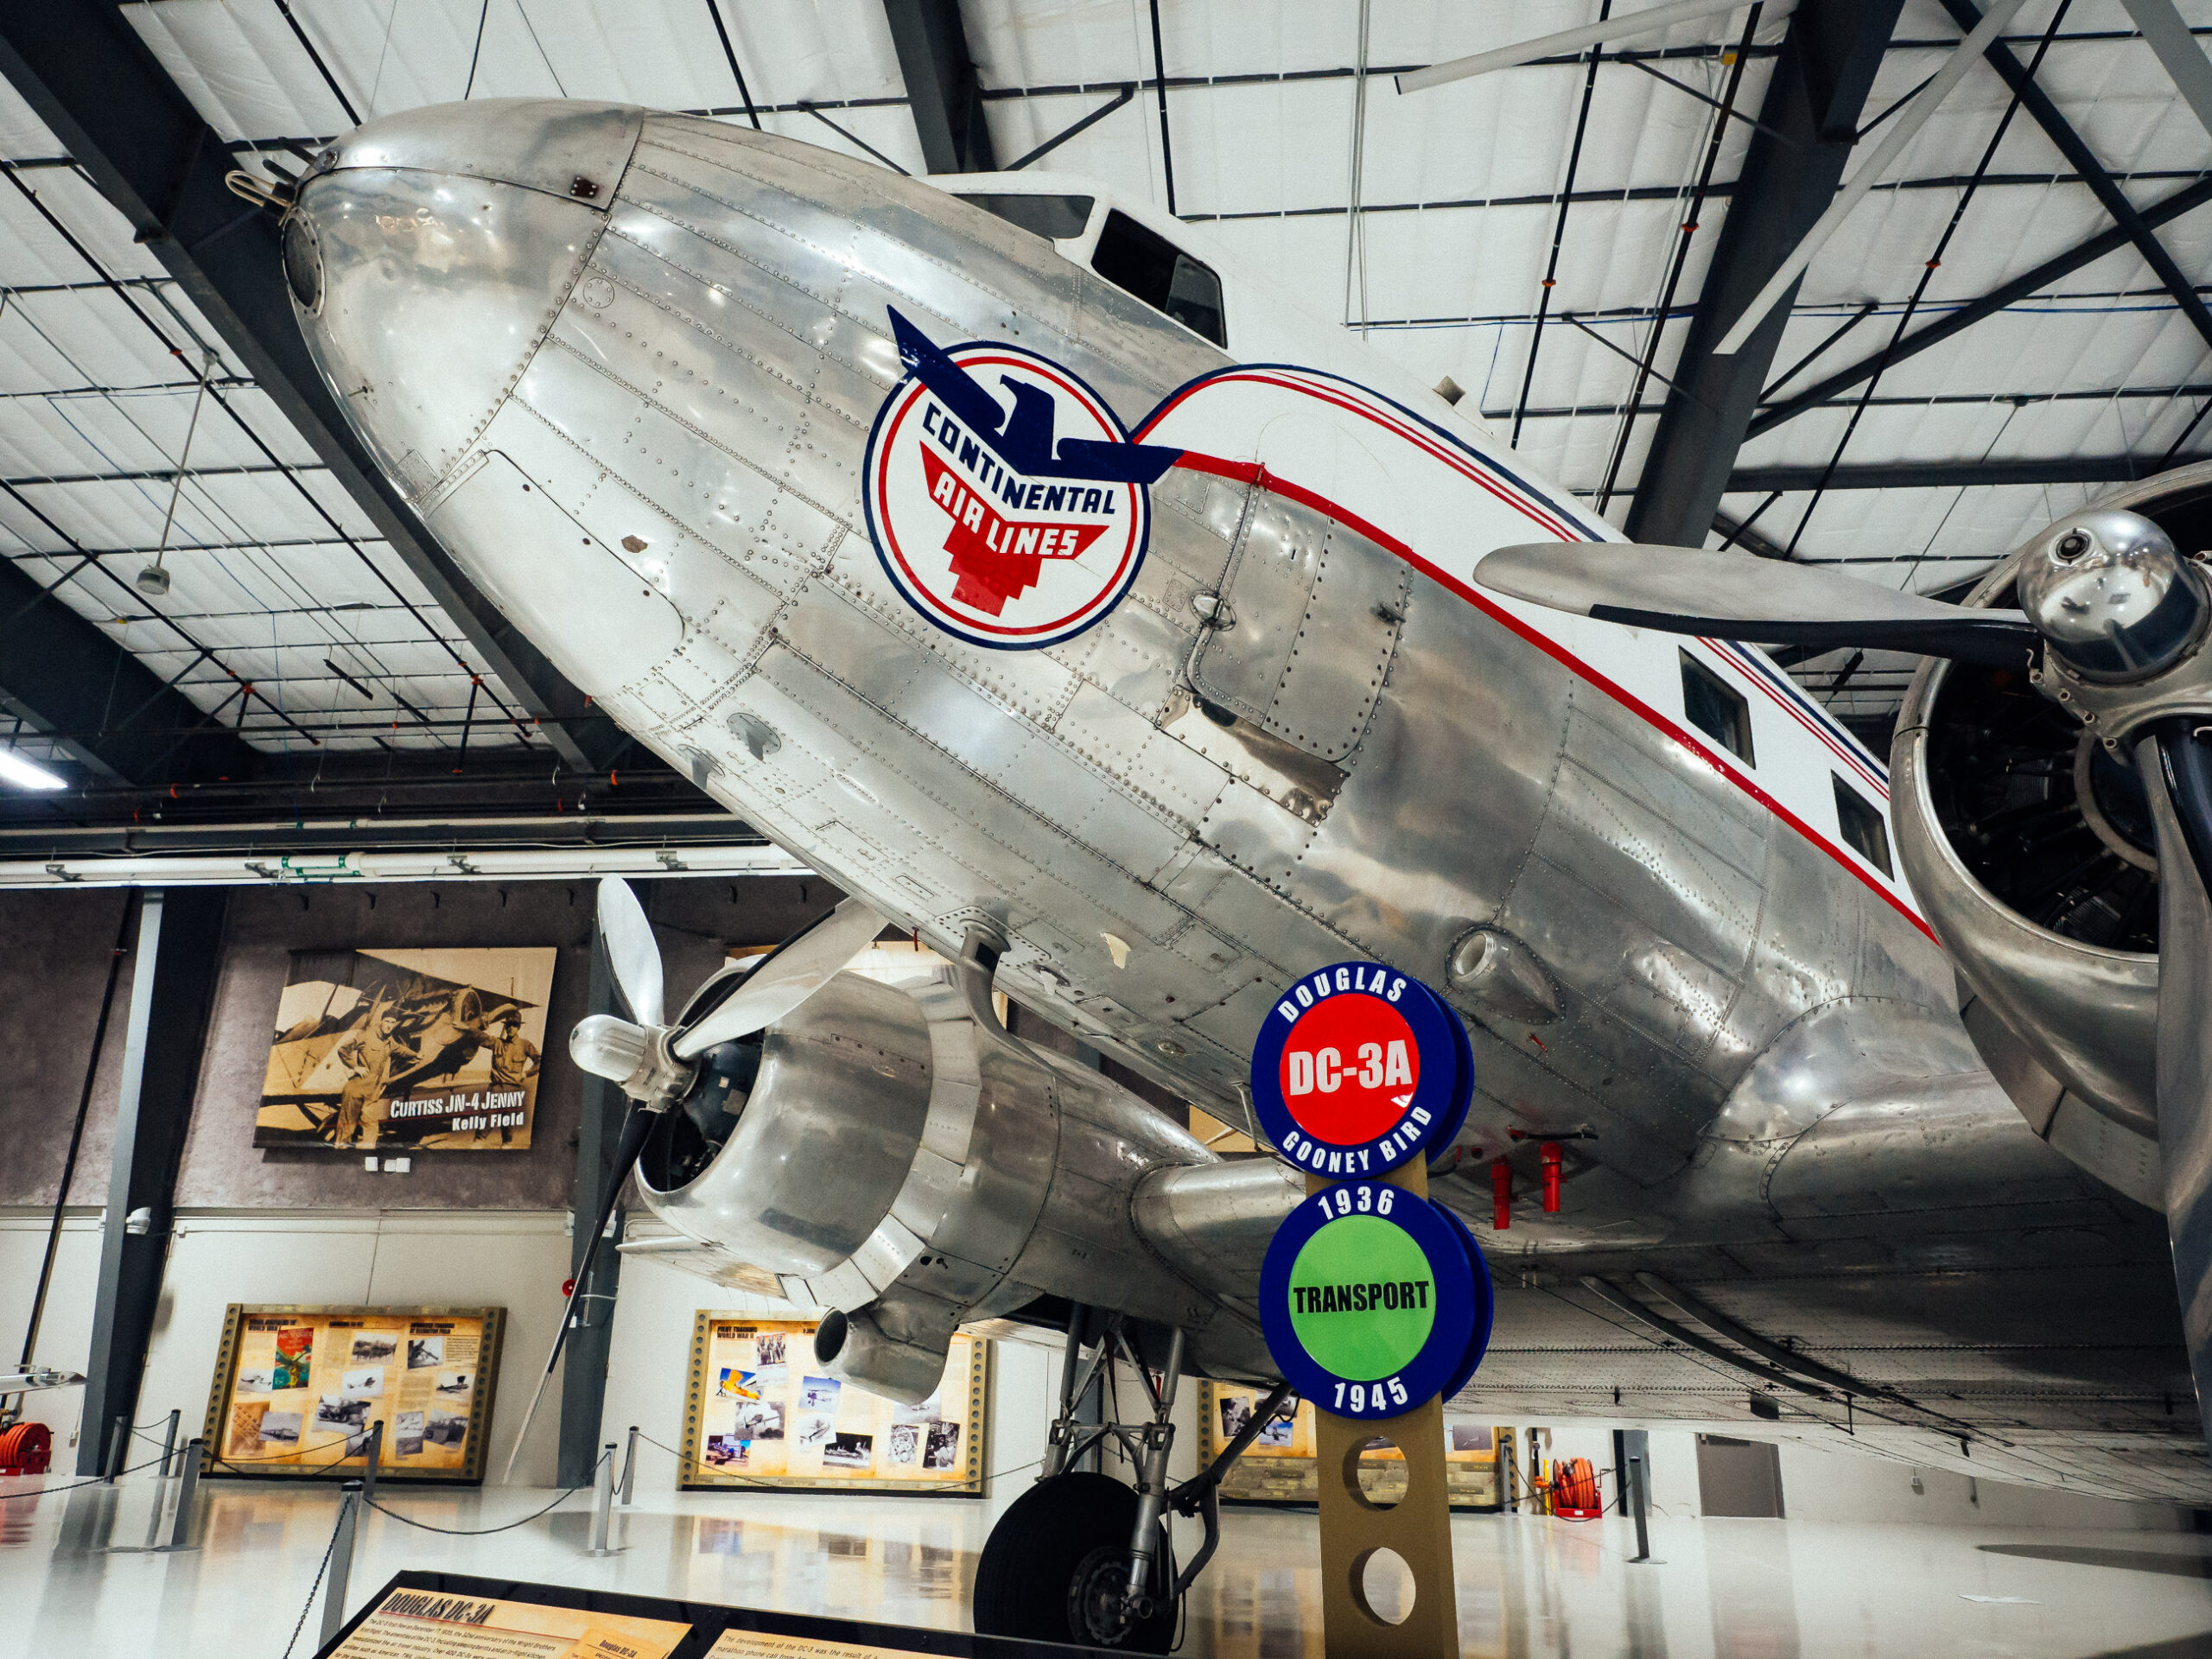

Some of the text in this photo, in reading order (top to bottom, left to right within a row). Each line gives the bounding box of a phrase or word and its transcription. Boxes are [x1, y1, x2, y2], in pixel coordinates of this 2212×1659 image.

[923, 402, 1116, 514] CONTINENTAL
[933, 471, 1079, 556] AIR LINES
[1278, 967, 1407, 1023] DOUGLAS
[1288, 1039, 1413, 1096] DC-3A
[390, 1090, 526, 1119] CURTISS JN-4 JENNY
[452, 1112, 524, 1131] Kelly Field
[1282, 1106, 1432, 1173] GOONEY BIRD
[1318, 1186, 1395, 1220] 1936
[1293, 1281, 1429, 1314] TRANSPORT
[1334, 1376, 1408, 1414] 1945
[380, 1592, 496, 1624] DOUGLAS DC-3A
